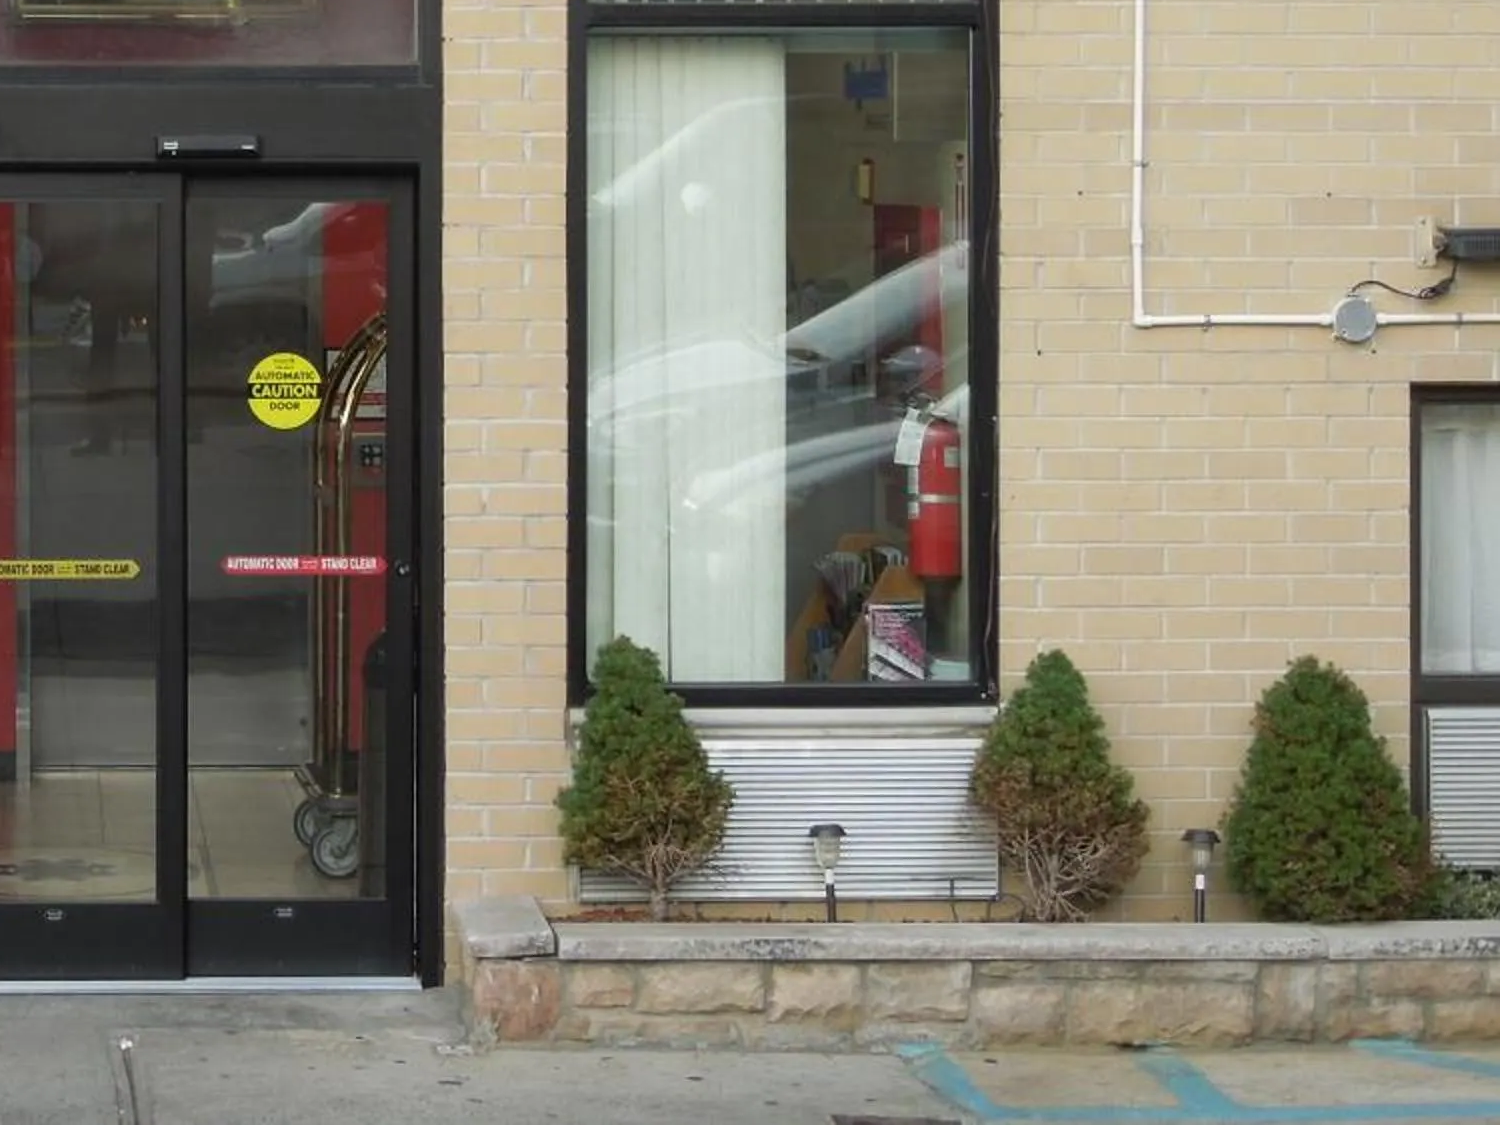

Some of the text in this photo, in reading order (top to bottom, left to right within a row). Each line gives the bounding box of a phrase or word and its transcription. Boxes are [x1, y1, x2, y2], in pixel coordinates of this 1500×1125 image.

[256, 371, 315, 380] AUTOMATIC
[251, 384, 318, 398] CAUTION
[269, 402, 301, 410] DOOR
[227, 557, 274, 569] AUTOMATIC
[275, 557, 299, 569] DOOR
[321, 557, 349, 569] STAND
[350, 557, 377, 569] CLEAR
[31, 564, 54, 574] DOOR
[74, 564, 101, 574] STAND
[103, 564, 130, 574] CLEAR
